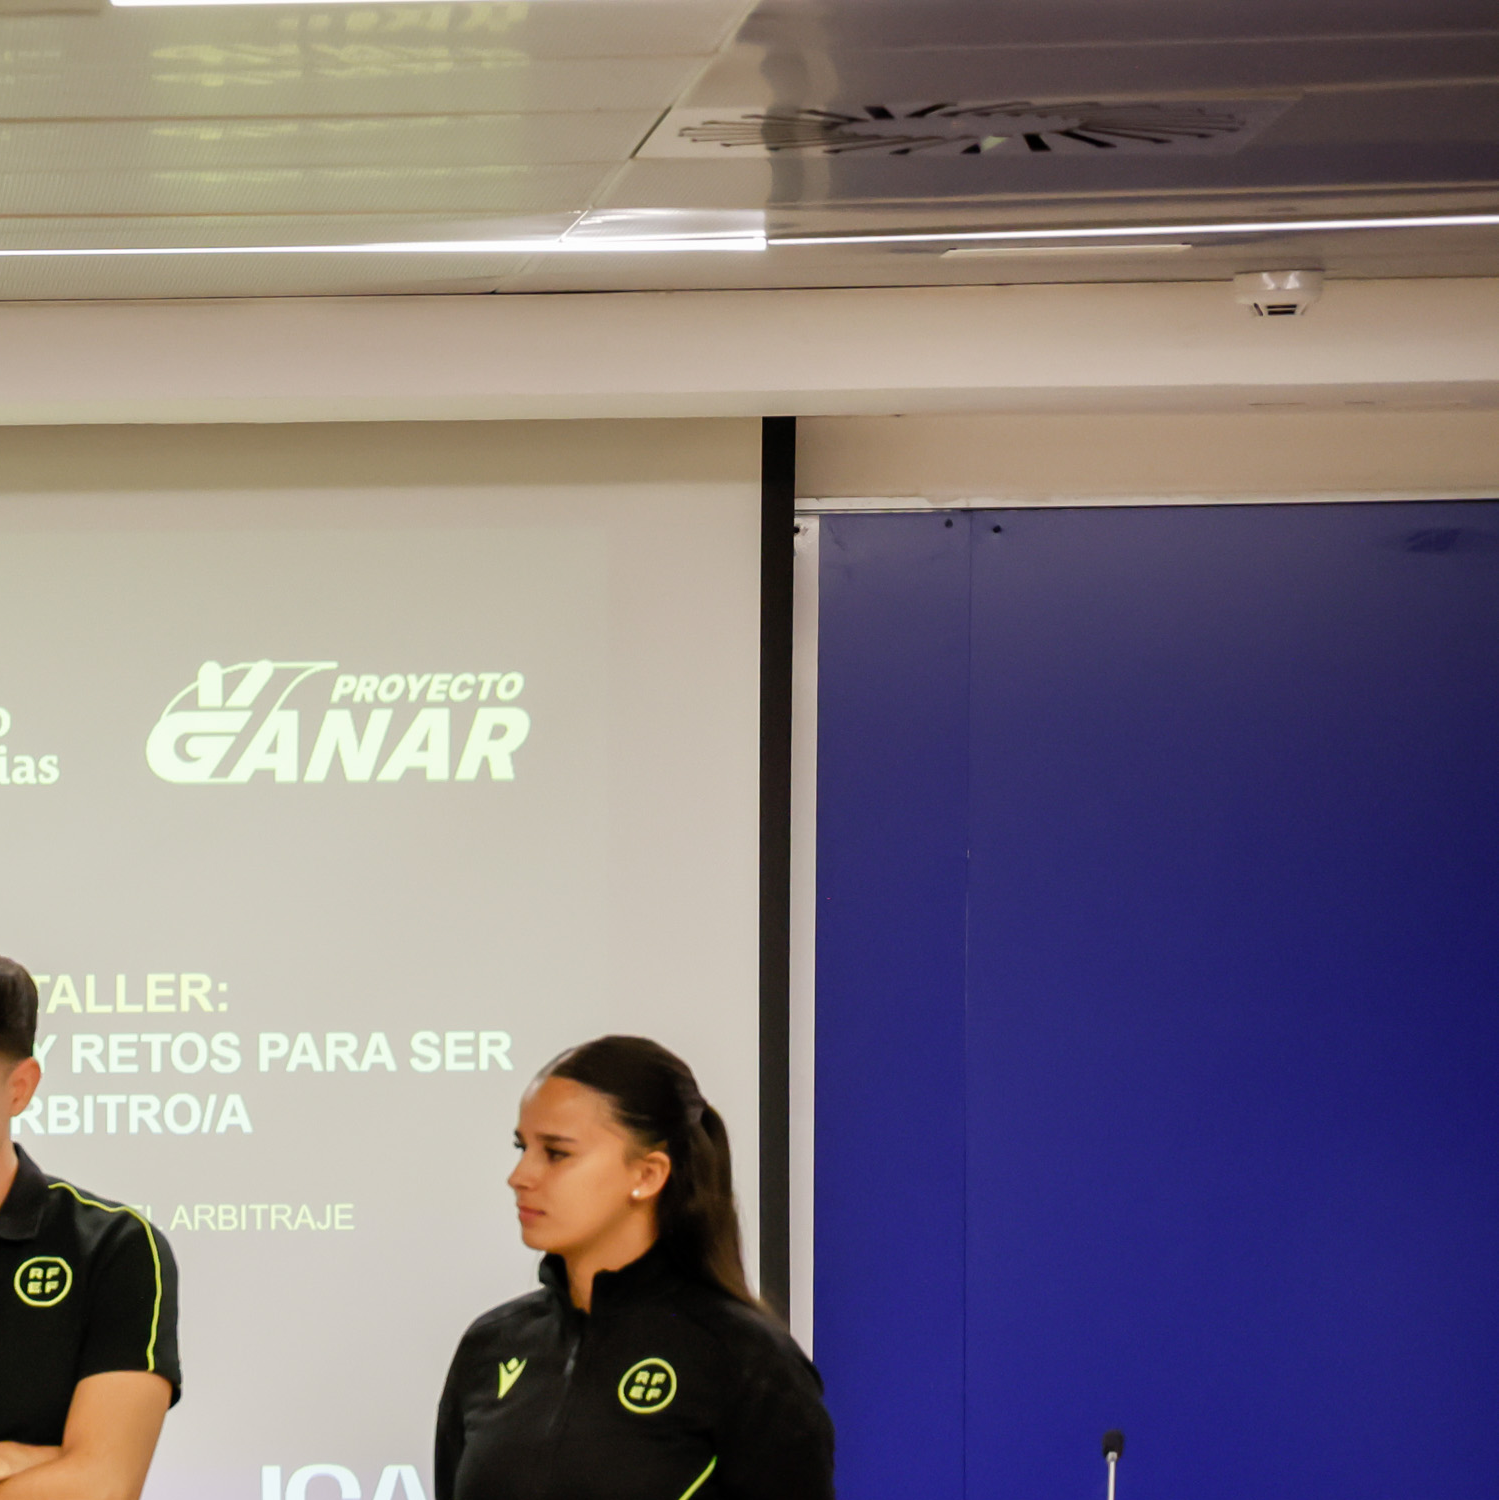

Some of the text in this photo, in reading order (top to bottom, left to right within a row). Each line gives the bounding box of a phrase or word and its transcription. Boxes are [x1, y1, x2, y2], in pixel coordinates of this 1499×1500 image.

[330, 671, 525, 704] PROYECTO
[145, 705, 531, 784] GANAR
[72, 1031, 242, 1074] RETOS
[258, 1032, 397, 1073] PARA
[409, 1030, 514, 1073] SER
[169, 1203, 355, 1231] ARBITRAJE
